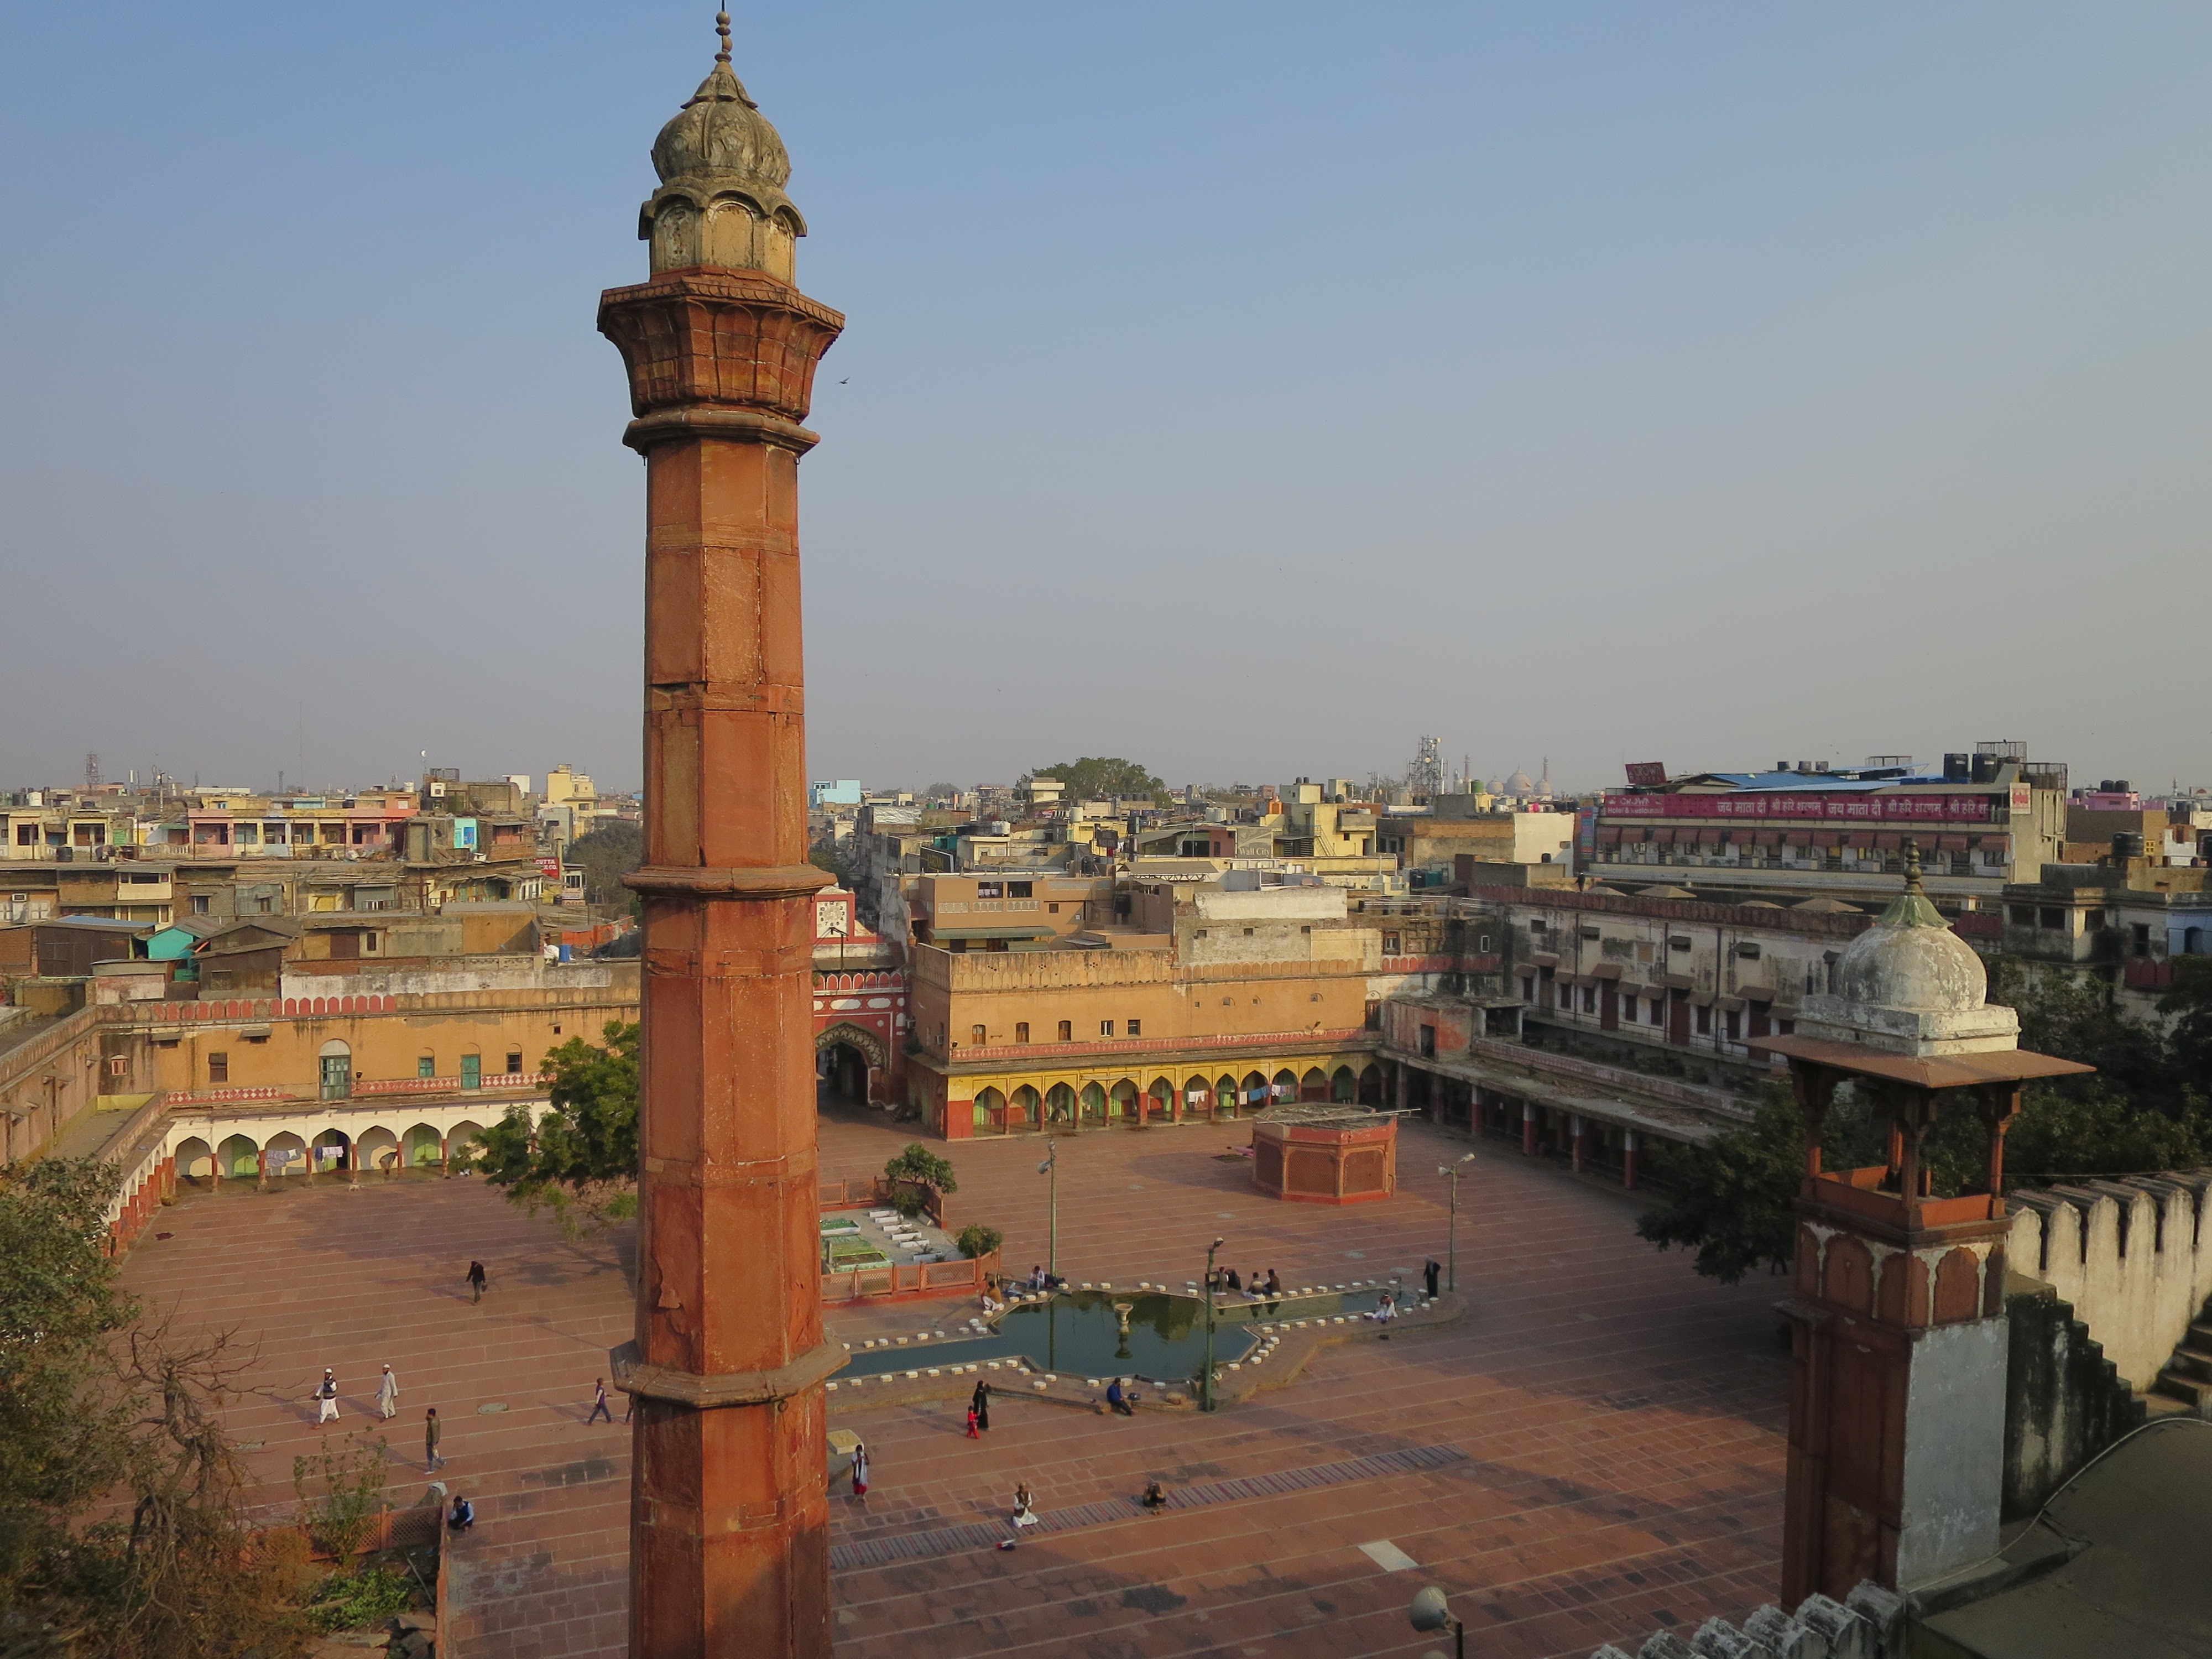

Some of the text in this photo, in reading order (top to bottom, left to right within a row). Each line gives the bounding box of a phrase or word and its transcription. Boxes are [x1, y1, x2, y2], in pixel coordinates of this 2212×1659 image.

[1717, 797, 1766, 814] जय माता दी
[1772, 798, 1781, 811] श्री
[1828, 799, 1881, 816] जय माता दी
[1887, 799, 1897, 812] श्री
[1899, 799, 1912, 813] हरि
[1949, 799, 1959, 813] श्री
[1962, 799, 1975, 814] हरि
[1239, 847, 1270, 857] Wall City
